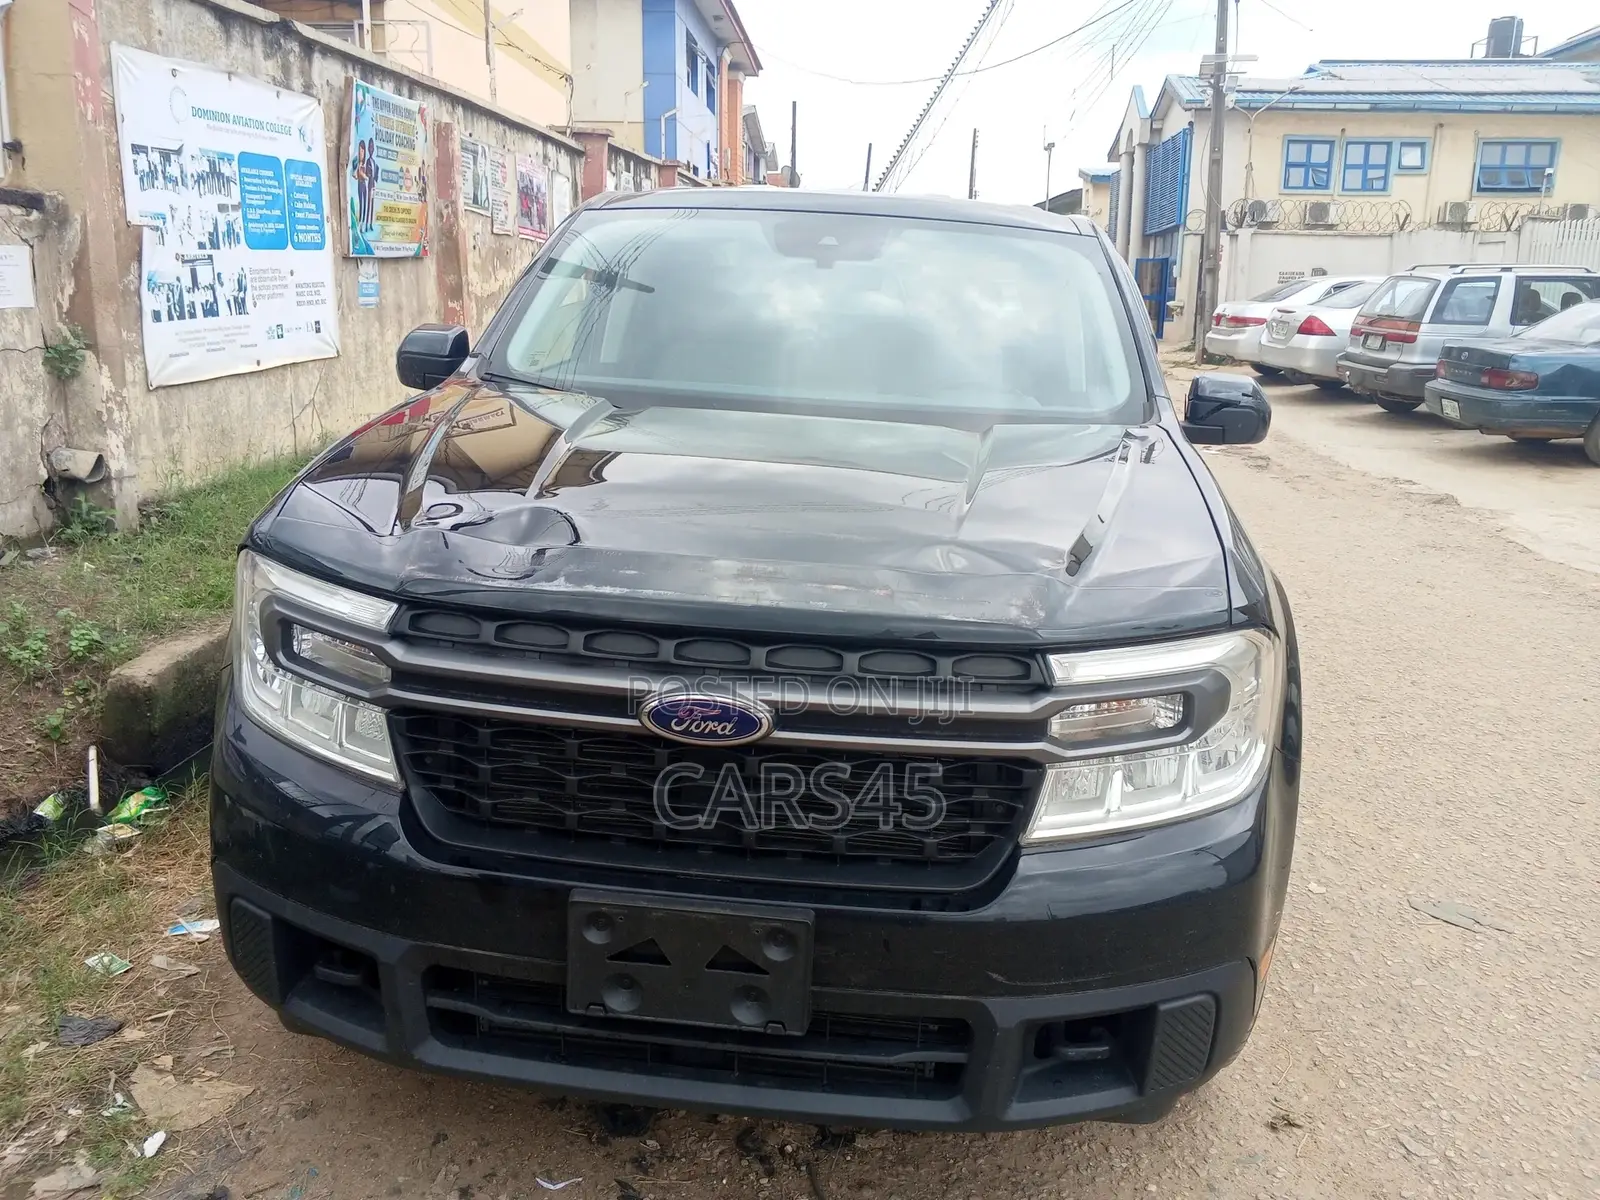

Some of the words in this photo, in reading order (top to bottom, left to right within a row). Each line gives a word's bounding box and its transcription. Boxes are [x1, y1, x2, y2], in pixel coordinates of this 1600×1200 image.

[191, 106, 230, 124] DOMINION
[232, 114, 264, 131] AVIATION
[265, 121, 292, 136] COLLEGE
[298, 233, 321, 243] MONTHS
[671, 705, 738, 737] Ford
